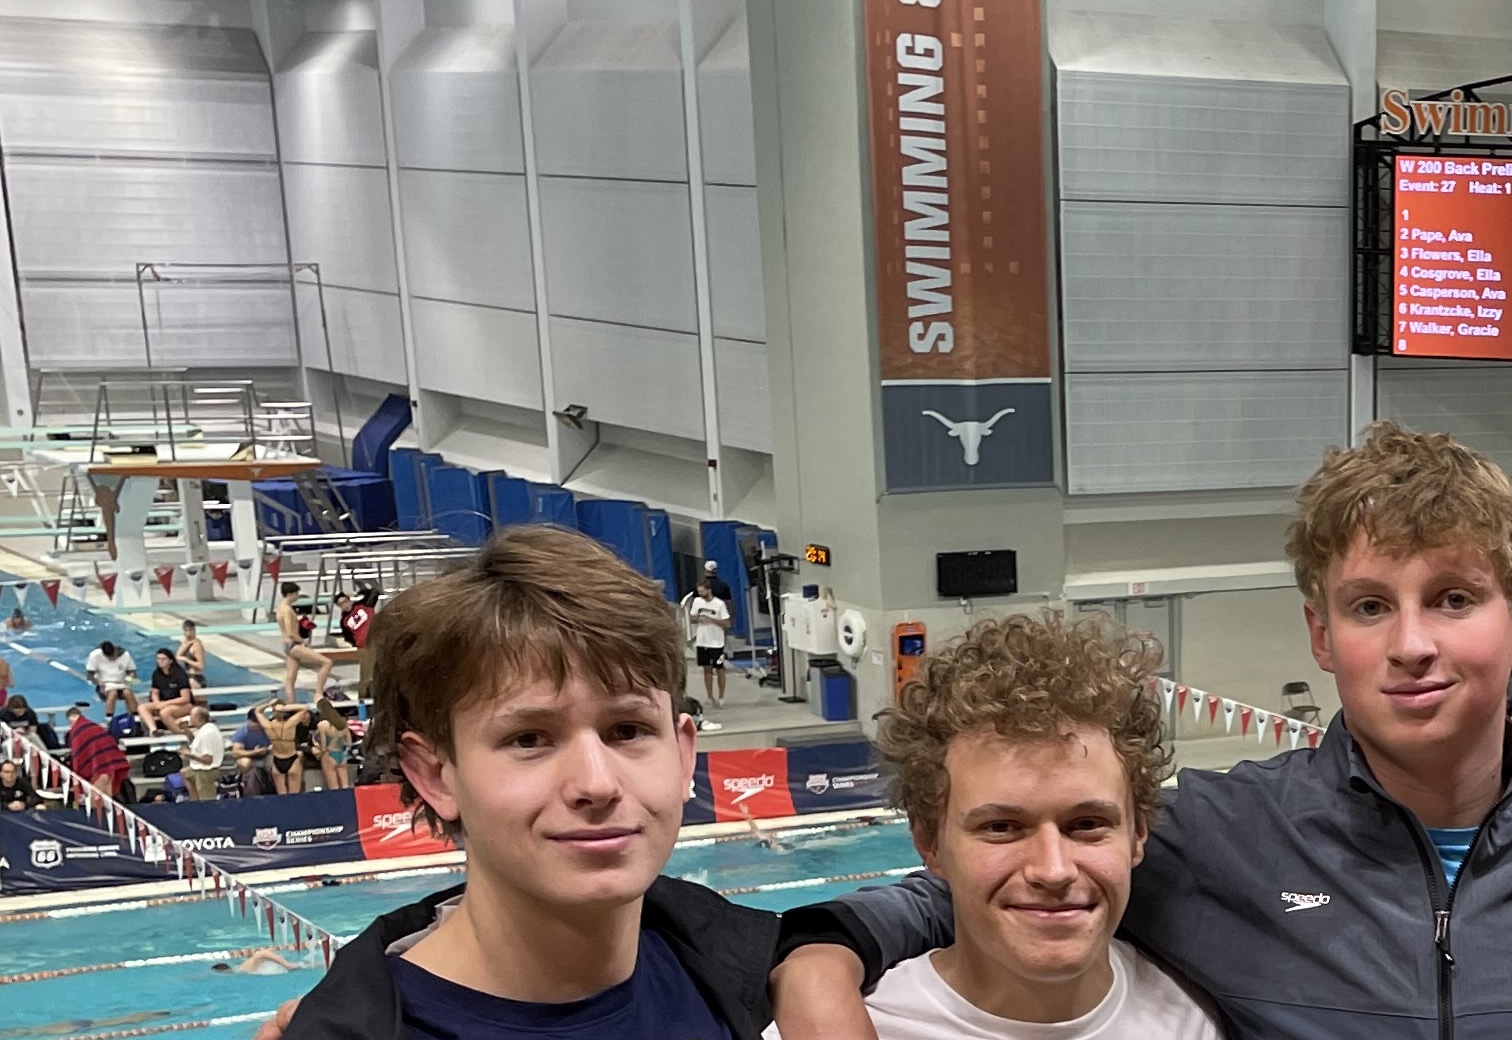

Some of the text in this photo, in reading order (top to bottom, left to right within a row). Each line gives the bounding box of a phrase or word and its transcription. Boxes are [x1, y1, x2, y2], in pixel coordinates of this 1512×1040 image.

[1400, 160, 1415, 173] W
[1417, 161, 1442, 174] 200
[1444, 161, 1479, 175] Back
[896, 33, 954, 354] SWIMMING
[1399, 179, 1438, 192] Event:
[1440, 181, 1456, 192] 27
[1469, 181, 1502, 194] Heat:
[1505, 183, 1512, 194] 1
[1402, 209, 1409, 221] 1
[1400, 228, 1409, 240] 2
[1411, 228, 1447, 243] Pape,
[1448, 230, 1473, 242] Ava
[1400, 248, 1409, 260] 3
[1467, 249, 1492, 263] Ella
[1400, 266, 1409, 278] 4
[1411, 266, 1474, 282] Cosgrove,
[1476, 268, 1502, 282] Ella
[1399, 284, 1408, 296] 5
[1409, 285, 1480, 300] Casperson,
[1481, 287, 1507, 300] Ava
[1399, 303, 1408, 315] 6
[1477, 305, 1503, 320] Izzy
[1398, 321, 1407, 332] 7
[1409, 321, 1455, 336] Walker,
[1457, 323, 1500, 337] Gracie
[1398, 339, 1407, 351] 8
[723, 774, 775, 792] speedo
[174, 836, 235, 851] TOYOTA
[1280, 891, 1331, 906] speedo
